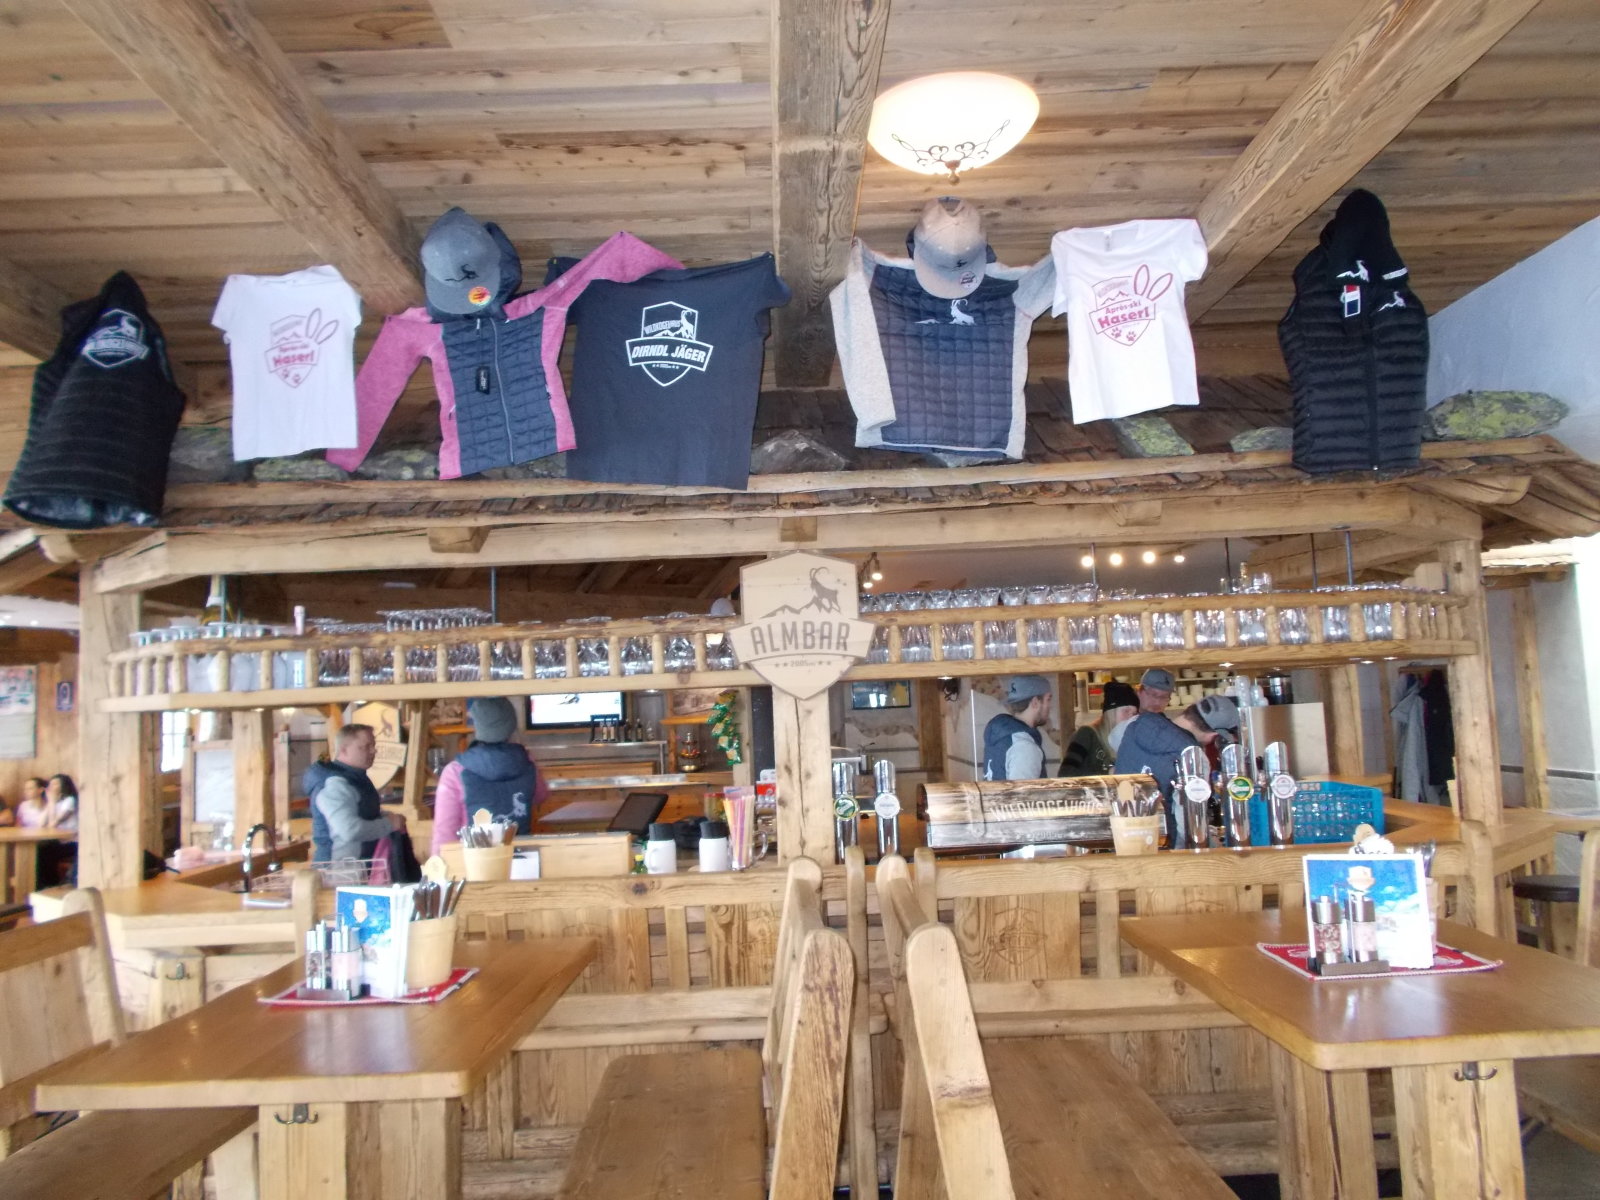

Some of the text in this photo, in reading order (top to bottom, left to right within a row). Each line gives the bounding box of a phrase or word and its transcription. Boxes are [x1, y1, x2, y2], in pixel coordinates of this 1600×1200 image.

[1097, 306, 1150, 329] Haserl
[631, 344, 707, 363] DIRNDL JÄGER
[750, 620, 851, 655] ALMBAR
